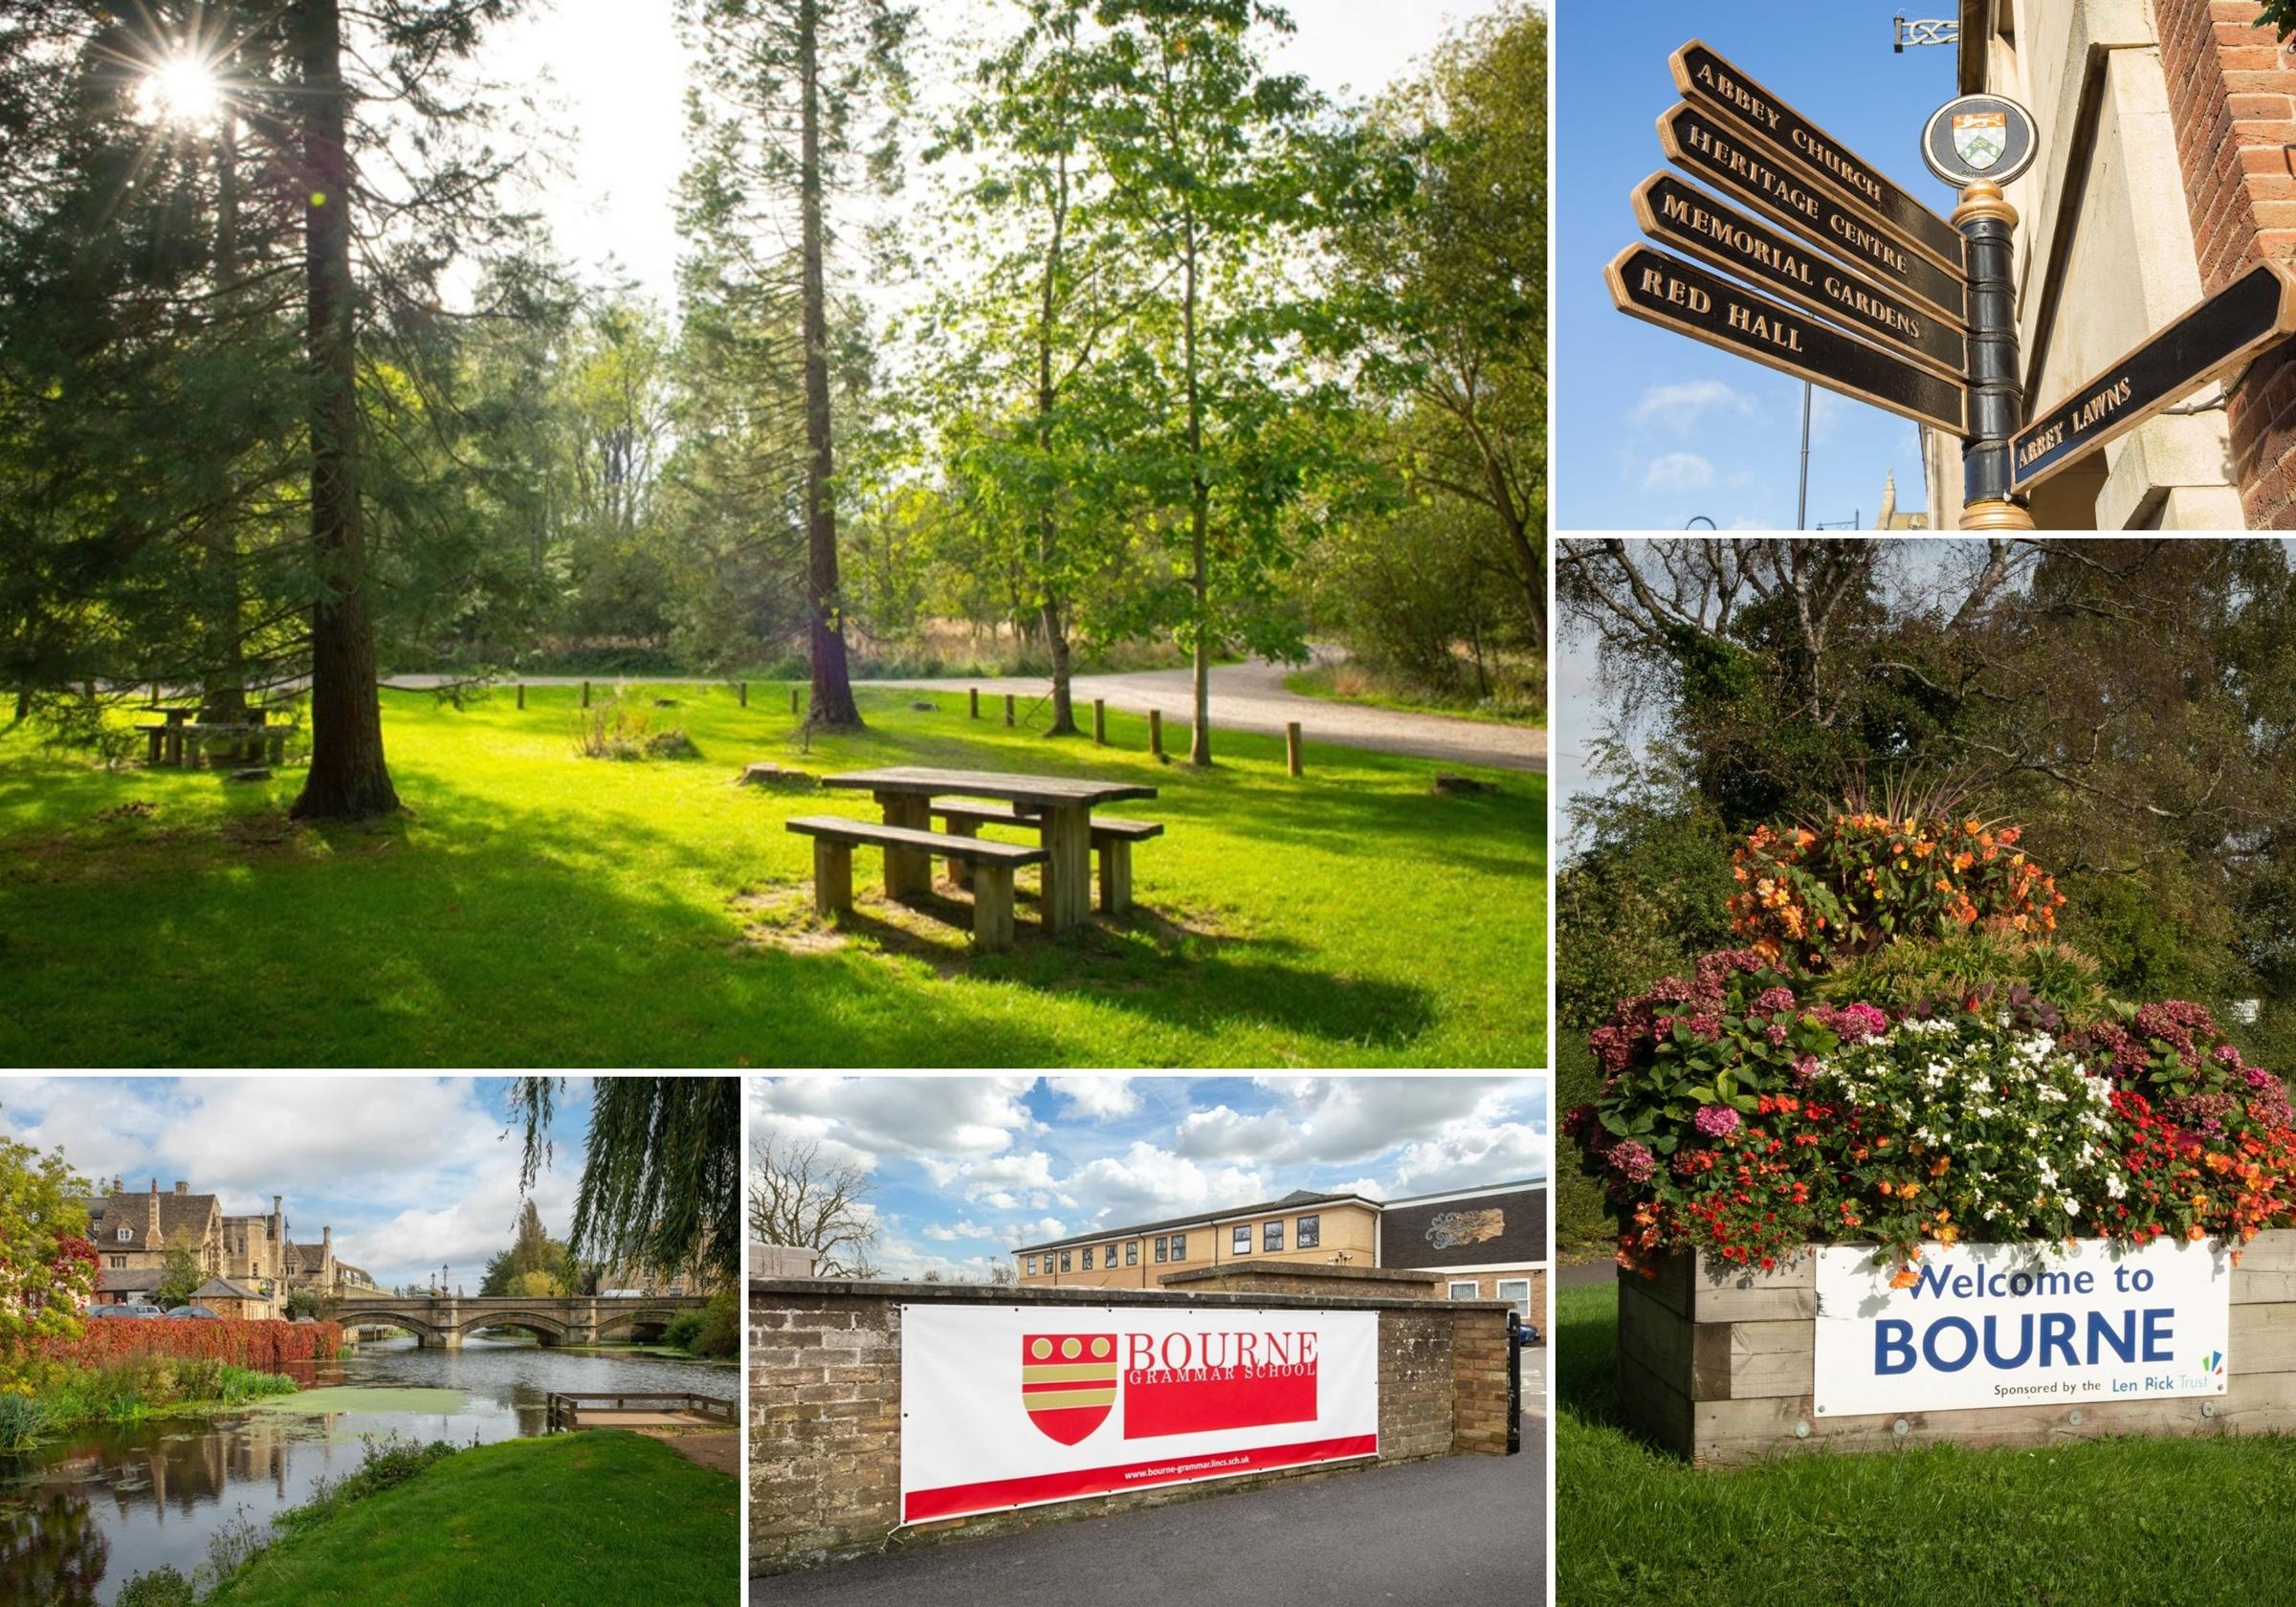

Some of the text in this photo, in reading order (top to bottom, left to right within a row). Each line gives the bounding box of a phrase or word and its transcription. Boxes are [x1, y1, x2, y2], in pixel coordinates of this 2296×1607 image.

[1696, 64, 1881, 203] ABBEY CHURCH
[1689, 124, 1907, 275] HERITAGE CENTRE
[1662, 194, 1919, 339] MEMORIAL GARDENS
[1640, 268, 1802, 352] RED HALL
[2019, 377, 2131, 470] ABBEY LAWNS
[1909, 1264, 2153, 1300] Welcome to
[1124, 1332, 1318, 1371] BOURNE
[1129, 1362, 1315, 1385] GRAMMAR SCHOOL
[1874, 1308, 2175, 1376] BOURNE
[1994, 1382, 2058, 1398] Sponsored
[2063, 1382, 2077, 1396] by
[2083, 1380, 2102, 1392] the
[2112, 1378, 2137, 1393] Len
[2179, 1375, 2208, 1388] Trust
[1124, 1456, 1249, 1480] www.bourne-grammar.lincs.sch.uk
